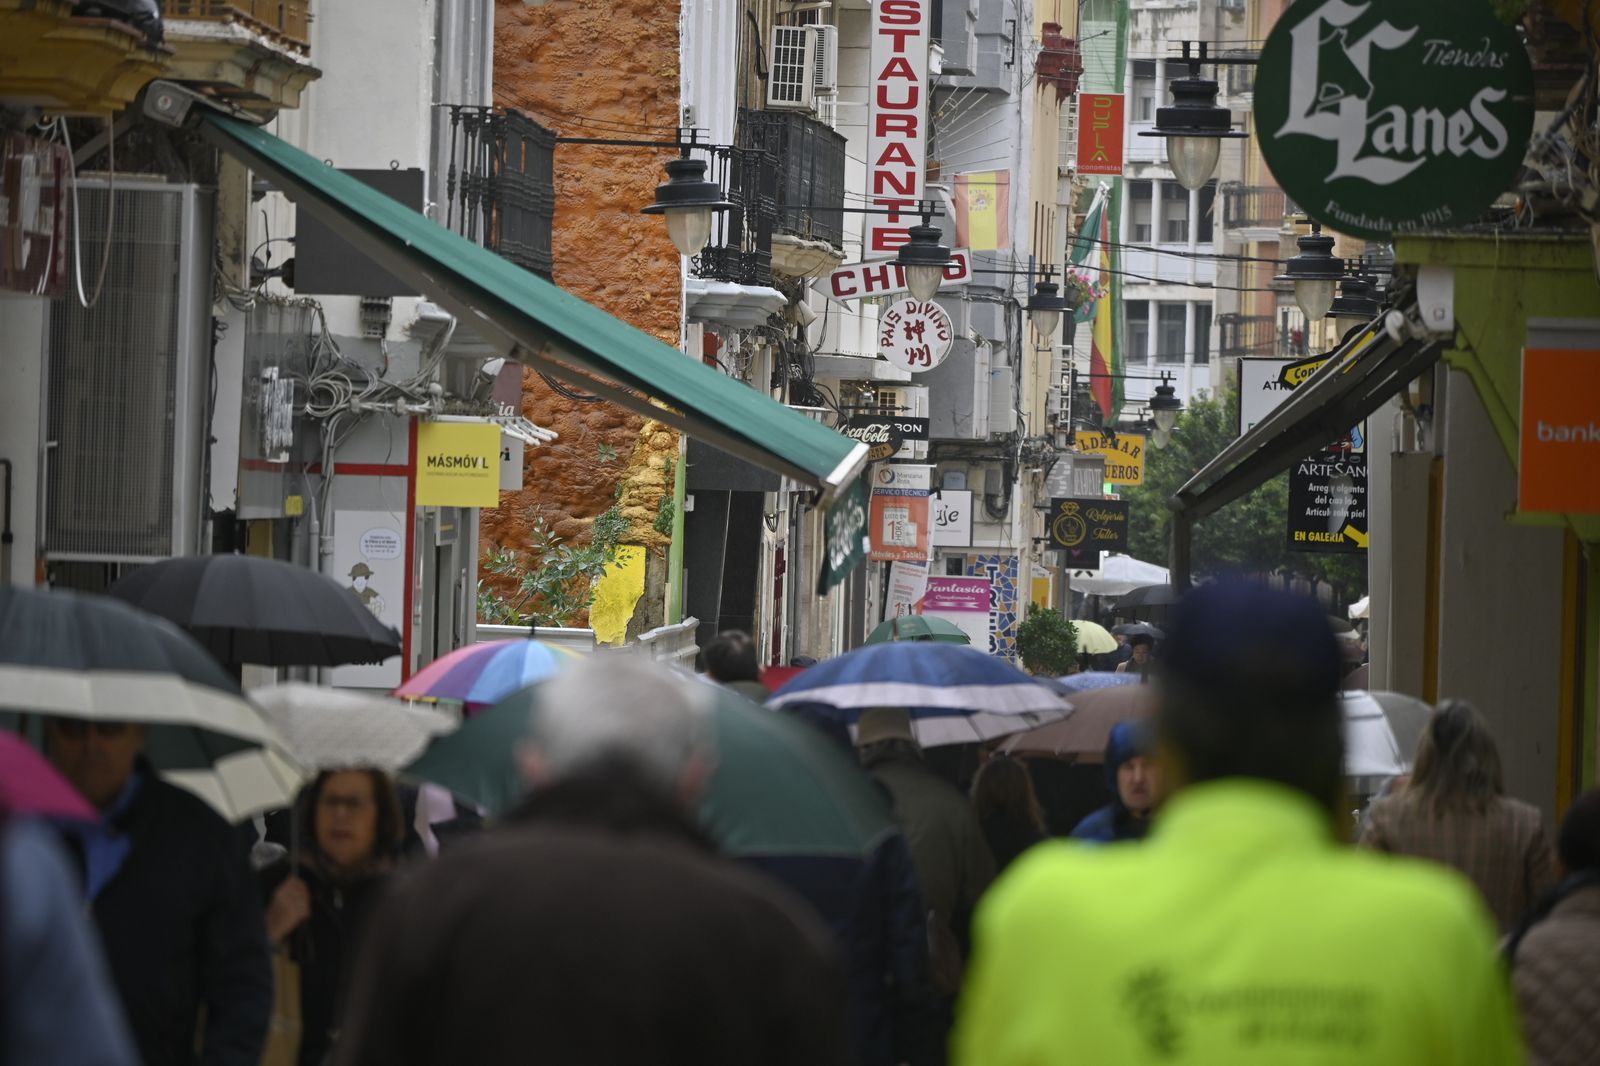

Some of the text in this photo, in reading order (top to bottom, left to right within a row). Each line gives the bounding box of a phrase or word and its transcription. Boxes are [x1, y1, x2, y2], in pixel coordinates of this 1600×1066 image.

[1421, 37, 1509, 69] Tiendas
[1324, 200, 1453, 232] Fundada en 1915
[830, 253, 967, 297] CHIO
[1298, 463, 1367, 478] ARTESAN
[887, 520, 895, 540] 1
[1294, 531, 1306, 541] EN
